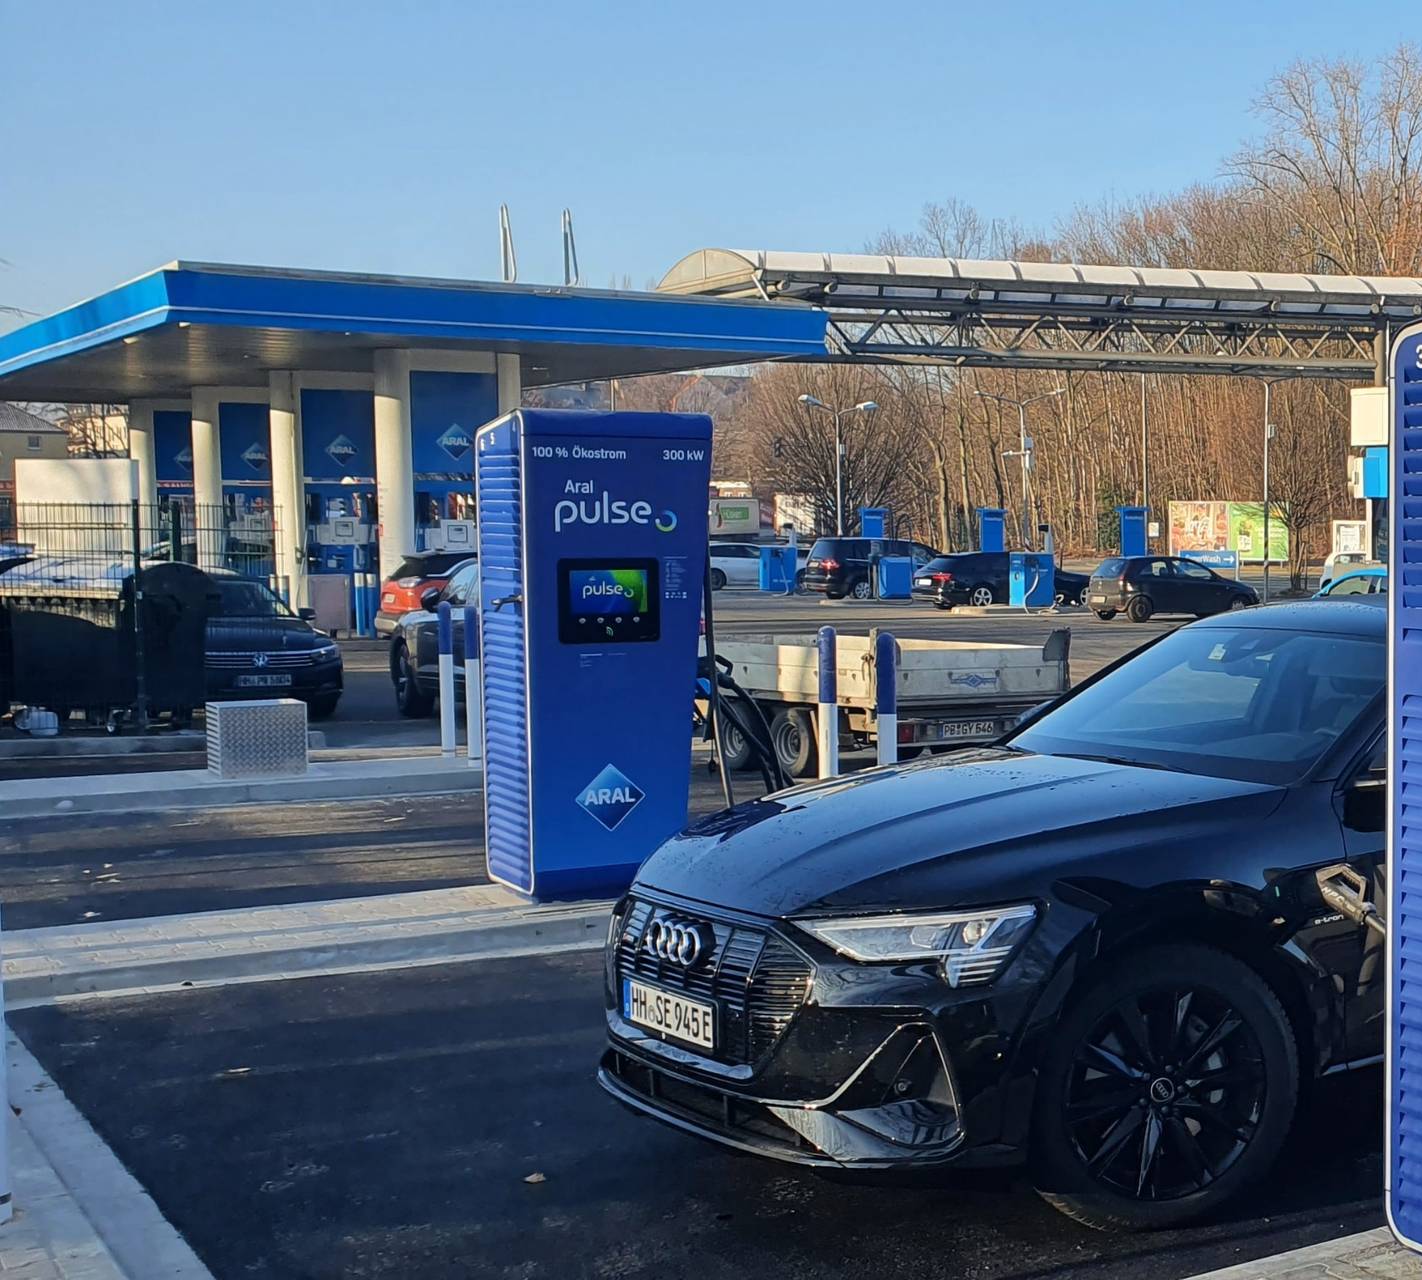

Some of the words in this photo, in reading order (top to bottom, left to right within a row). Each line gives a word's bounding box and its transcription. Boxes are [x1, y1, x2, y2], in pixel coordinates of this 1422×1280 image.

[441, 437, 470, 447] ARAL
[329, 445, 355, 455] ARAL
[532, 446, 553, 458] 100
[555, 447, 569, 458] %
[572, 445, 627, 460] Ökostrom
[662, 449, 685, 461] 300
[687, 450, 704, 461] kW
[564, 479, 594, 494] Aral
[554, 490, 652, 533] pulse
[582, 580, 624, 599] pulse
[961, 723, 974, 735] GY
[584, 786, 636, 807] ARAL
[631, 985, 647, 1020] HH
[655, 995, 672, 1029] SE
